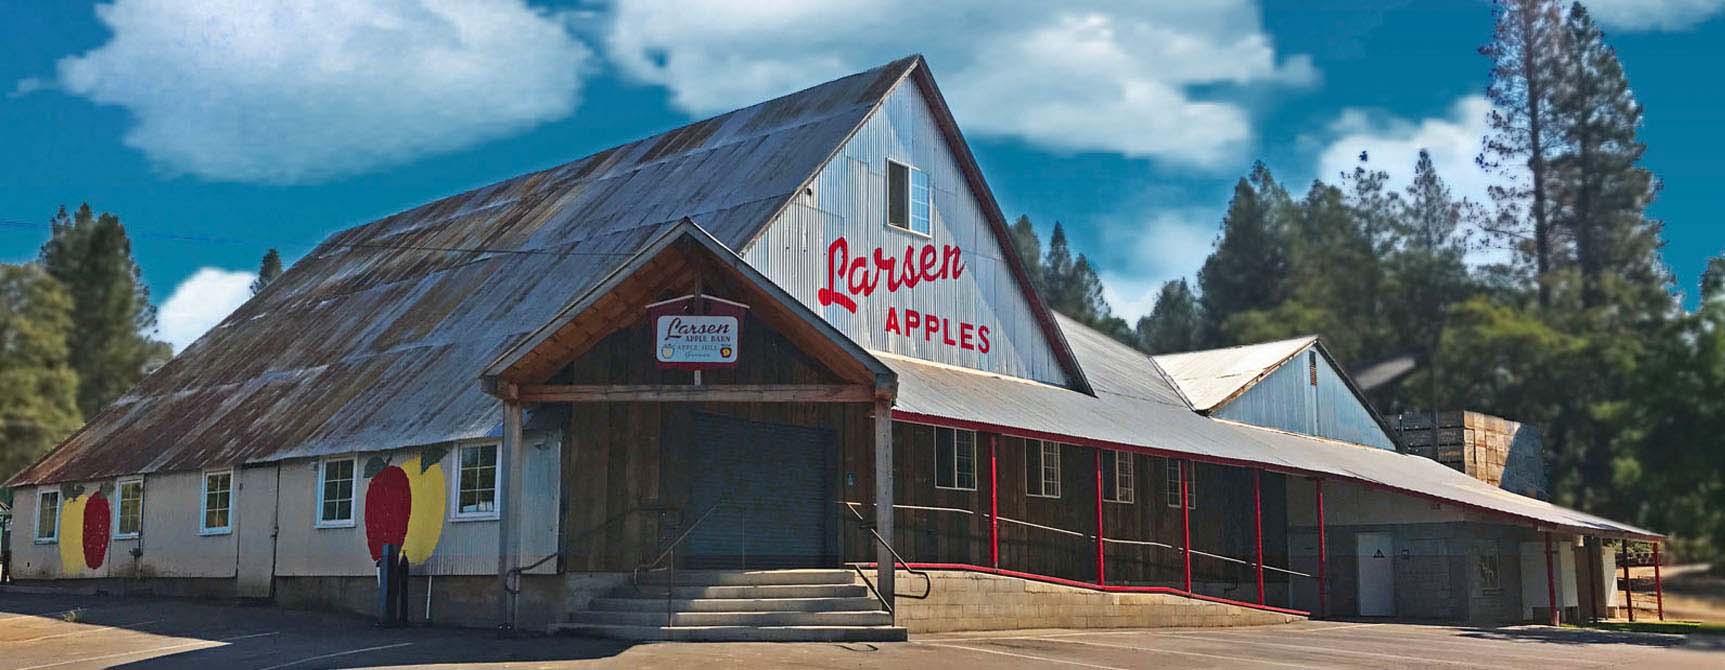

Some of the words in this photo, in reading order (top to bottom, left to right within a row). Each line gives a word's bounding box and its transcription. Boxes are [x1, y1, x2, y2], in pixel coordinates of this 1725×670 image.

[818, 236, 966, 314] Larsen
[664, 317, 730, 341] Larsen
[885, 307, 991, 354] APPLES
